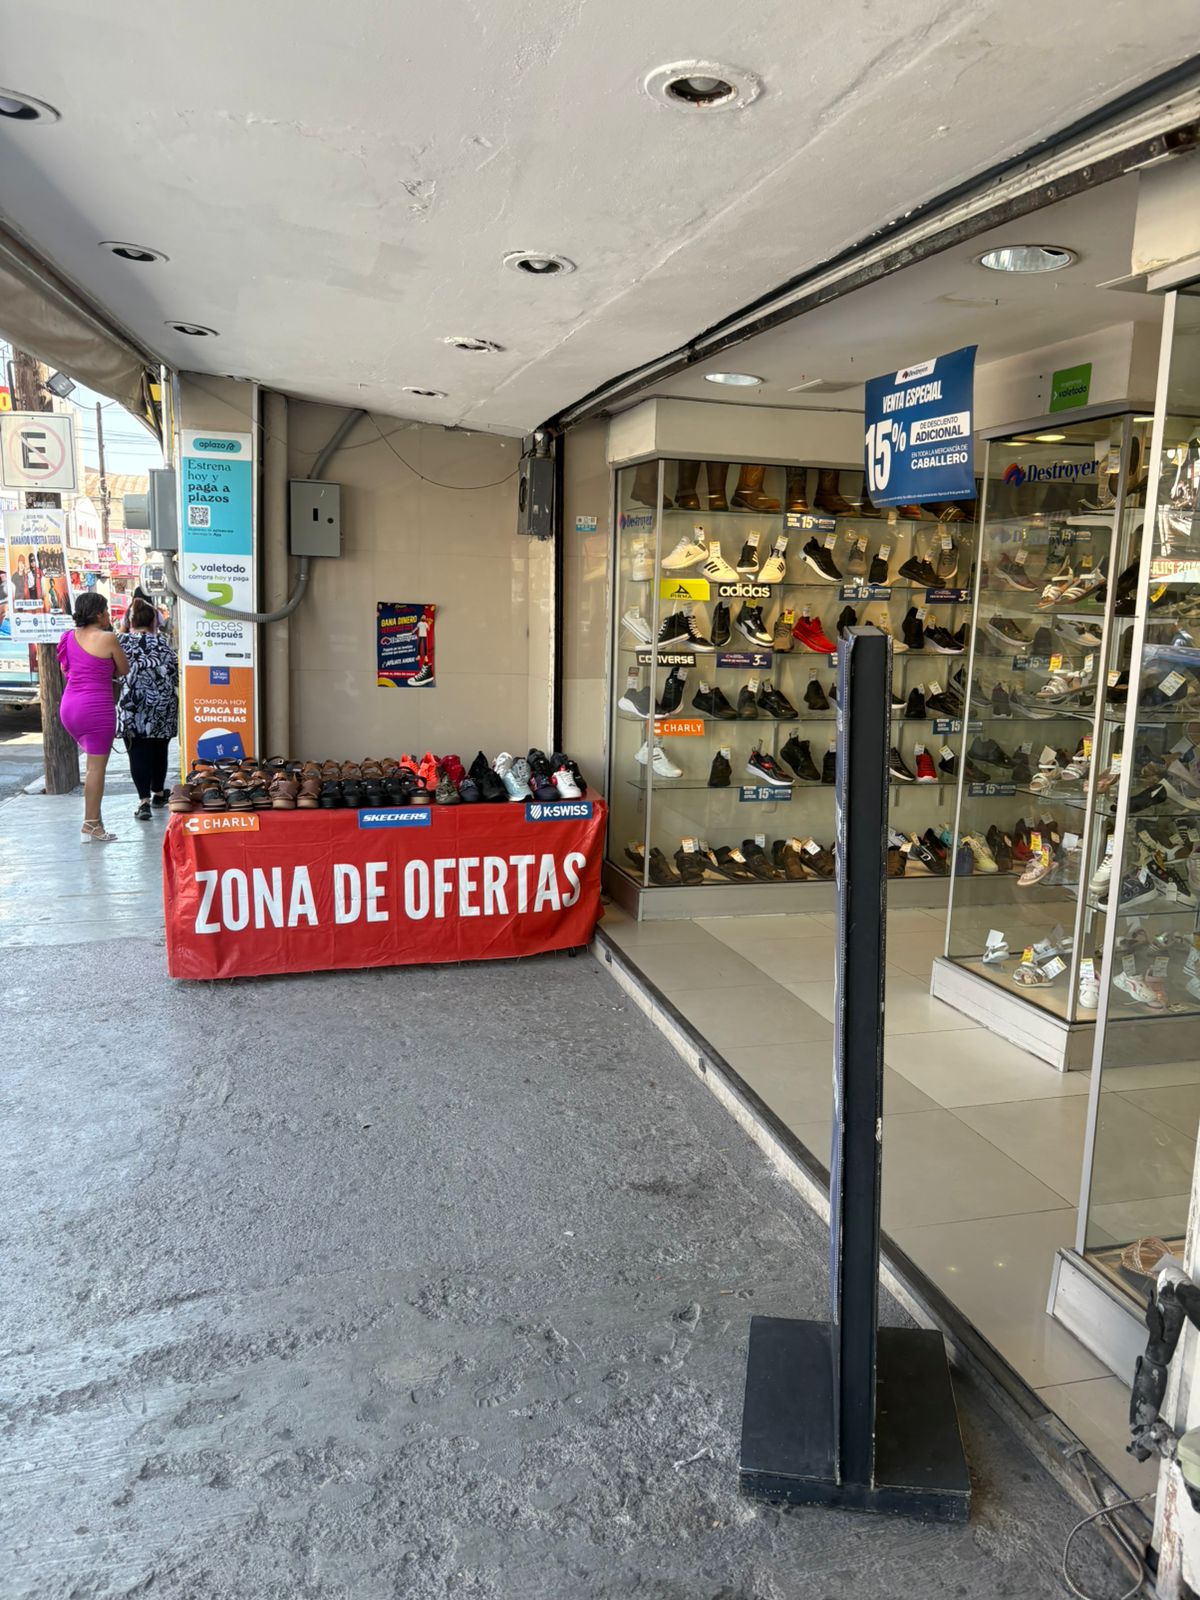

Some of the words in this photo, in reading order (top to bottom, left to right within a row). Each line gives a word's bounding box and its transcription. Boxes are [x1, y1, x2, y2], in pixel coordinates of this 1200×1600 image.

[882, 391, 904, 414] VENTA
[905, 380, 942, 408] ESPECIAL
[920, 422, 928, 430] DE
[928, 416, 958, 429] DESCUENTO
[915, 425, 963, 443] ADICIONAL
[21, 431, 49, 469] E
[199, 441, 226, 450] aplazo
[865, 418, 907, 492] 15%
[918, 450, 928, 458] TODA
[188, 459, 232, 472] Estrena
[911, 452, 968, 470] CABALLERO
[1027, 459, 1099, 483] Destroyer
[188, 471, 208, 482] hoy
[212, 474, 219, 483] y
[188, 484, 218, 493] paga
[222, 484, 230, 493] a
[188, 492, 229, 503] plazos
[200, 562, 246, 573] valetodo
[188, 573, 213, 581] compra
[214, 574, 226, 582] hoy
[233, 575, 249, 583] paga
[719, 583, 771, 598] adidas
[205, 583, 233, 619] 2
[196, 620, 243, 631] meses
[381, 617, 397, 628] GANA
[204, 630, 243, 640] después
[193, 698, 229, 706] COMPRA
[194, 706, 201, 714] Y
[202, 706, 231, 715] PAGA
[233, 707, 247, 715] EN
[193, 715, 247, 724] QUINCENAS
[663, 723, 702, 733] CHARLY
[202, 815, 256, 831] CHARLY
[362, 812, 429, 823] SKECHERS
[195, 866, 318, 935] ZONA
[333, 861, 389, 925] DE
[404, 851, 587, 921] OFERTAS
